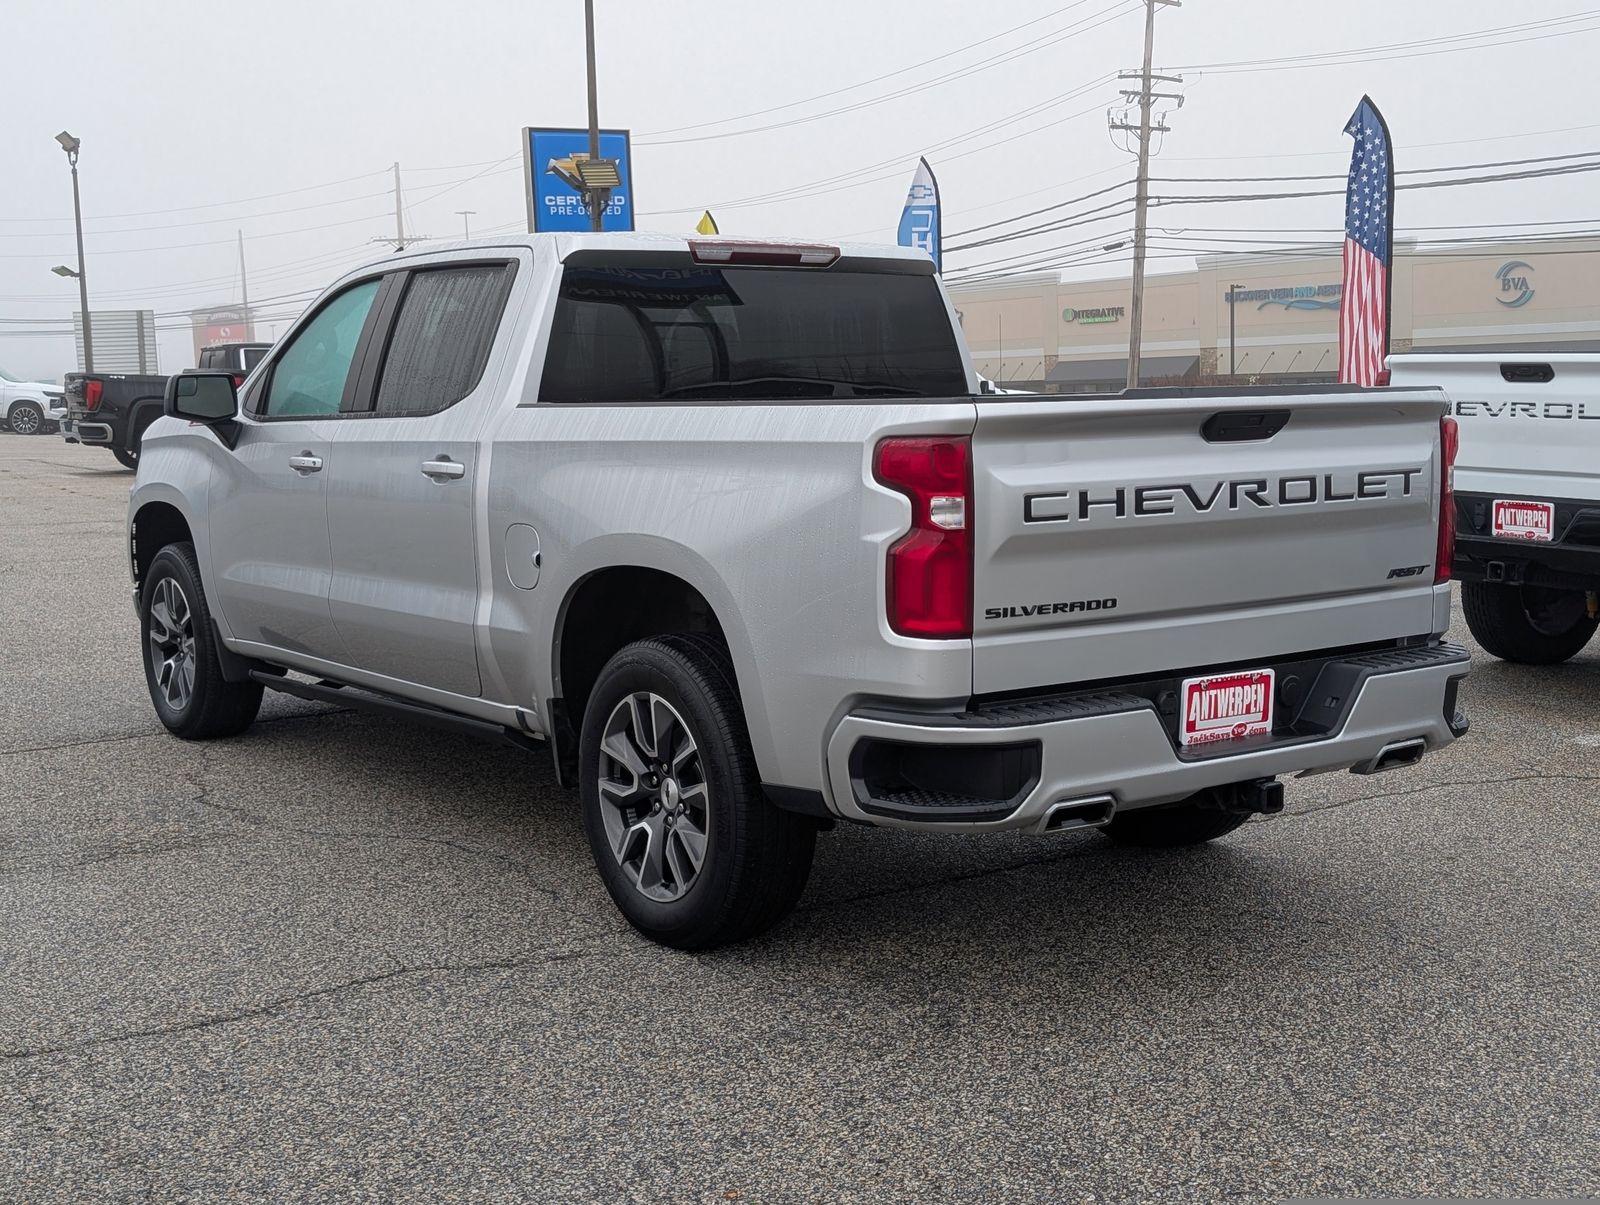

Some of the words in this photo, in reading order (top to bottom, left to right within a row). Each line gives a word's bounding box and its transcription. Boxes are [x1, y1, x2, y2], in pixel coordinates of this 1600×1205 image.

[550, 206, 621, 216] PRE-OED
[1293, 286, 1316, 298] AND
[1501, 276, 1529, 291] BVA
[1023, 468, 1422, 523] CHEVROLET
[1497, 507, 1548, 528] ANTWERPEN
[984, 598, 1118, 620] SILVERADO
[1189, 683, 1264, 721] ANTWERPEN
